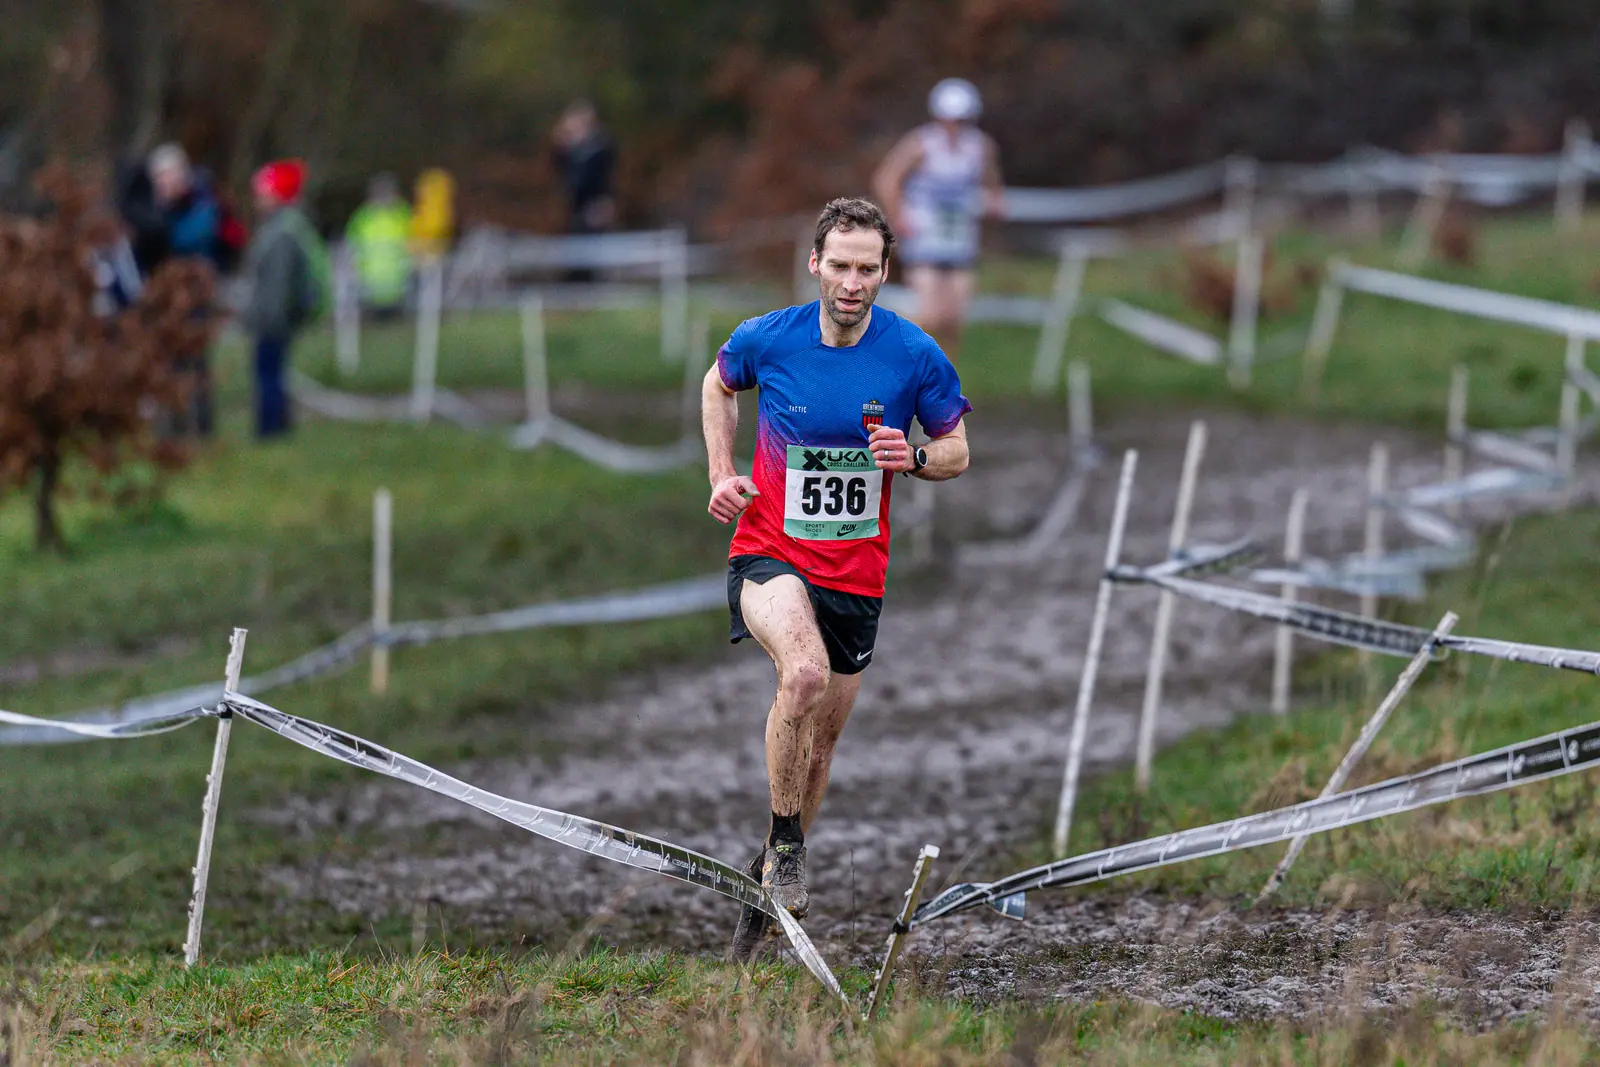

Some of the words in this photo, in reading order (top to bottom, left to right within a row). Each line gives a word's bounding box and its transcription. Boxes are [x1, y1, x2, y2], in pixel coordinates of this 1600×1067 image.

[789, 405, 807, 413] TACTIC
[827, 451, 869, 462] UKA
[802, 477, 867, 516] 536
